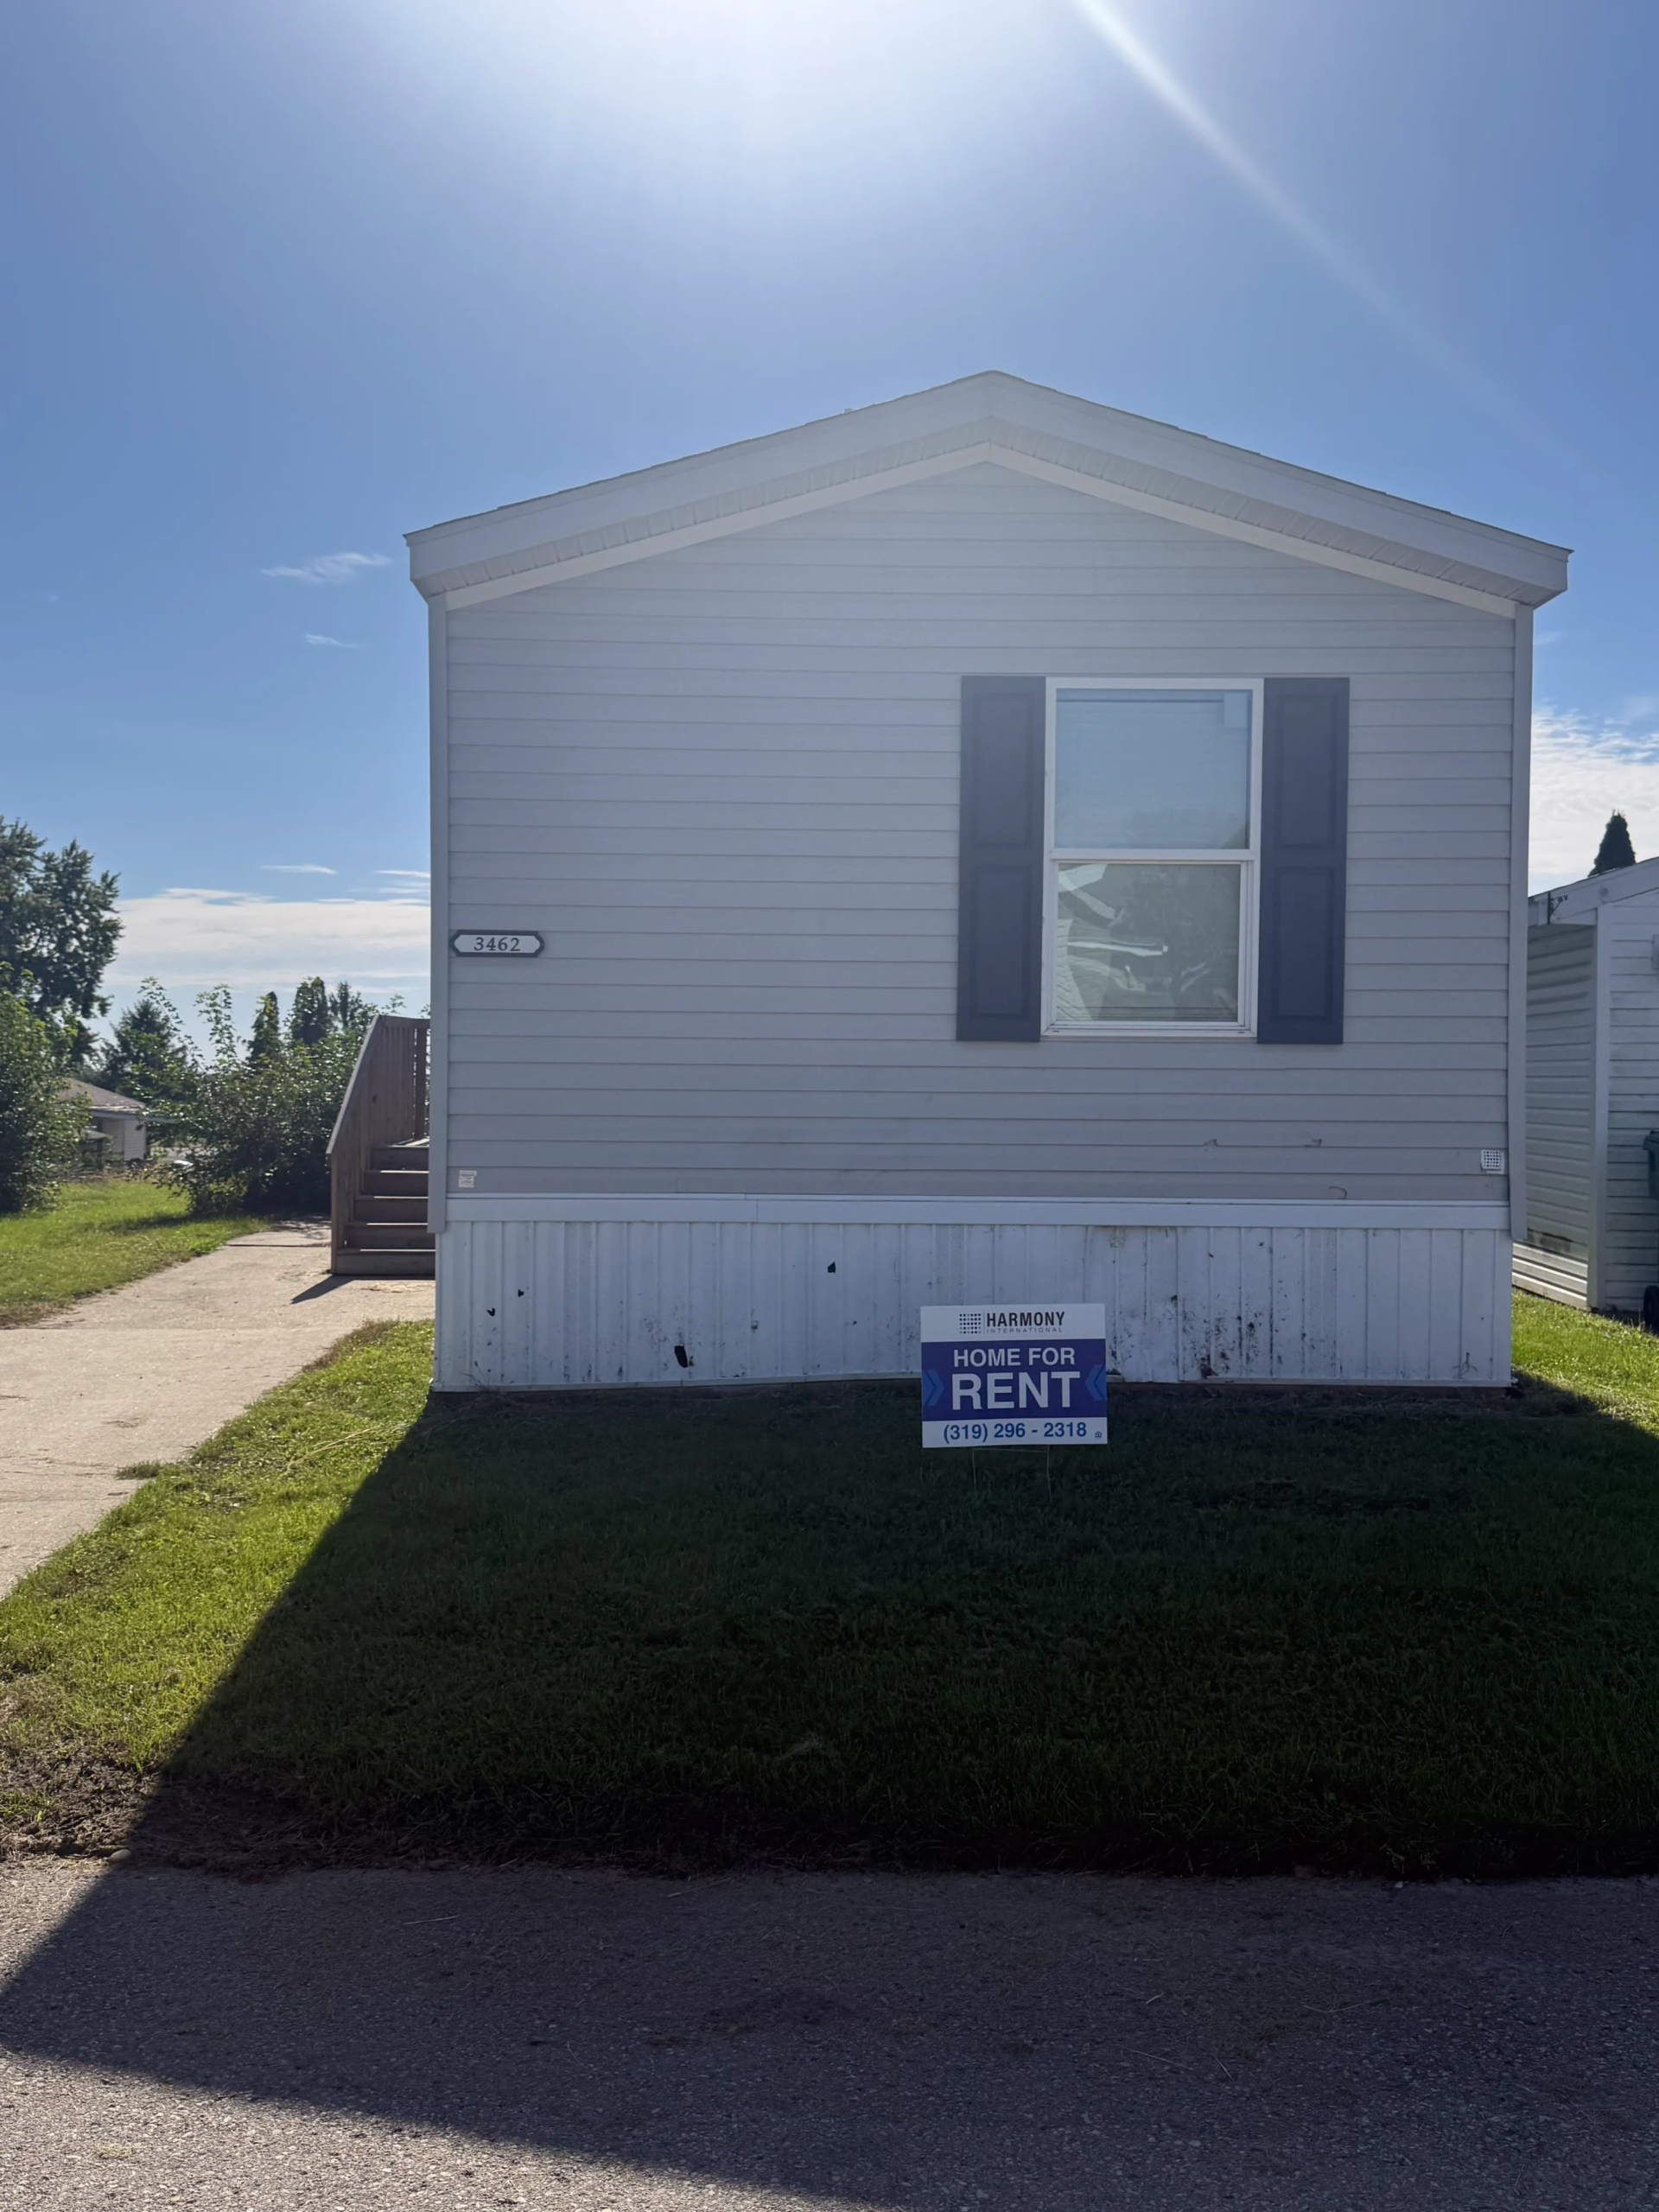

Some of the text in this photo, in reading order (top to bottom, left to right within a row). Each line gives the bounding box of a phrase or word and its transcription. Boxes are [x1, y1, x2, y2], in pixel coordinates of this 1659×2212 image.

[474, 937, 520, 951] 3462
[987, 1312, 1065, 1327] HARMONY
[953, 1347, 1075, 1367] HOME FOR
[951, 1371, 1080, 1410] RENT
[944, 1423, 988, 1444] (319)
[994, 1422, 1026, 1438] 296
[1043, 1421, 1087, 1437] 2318
